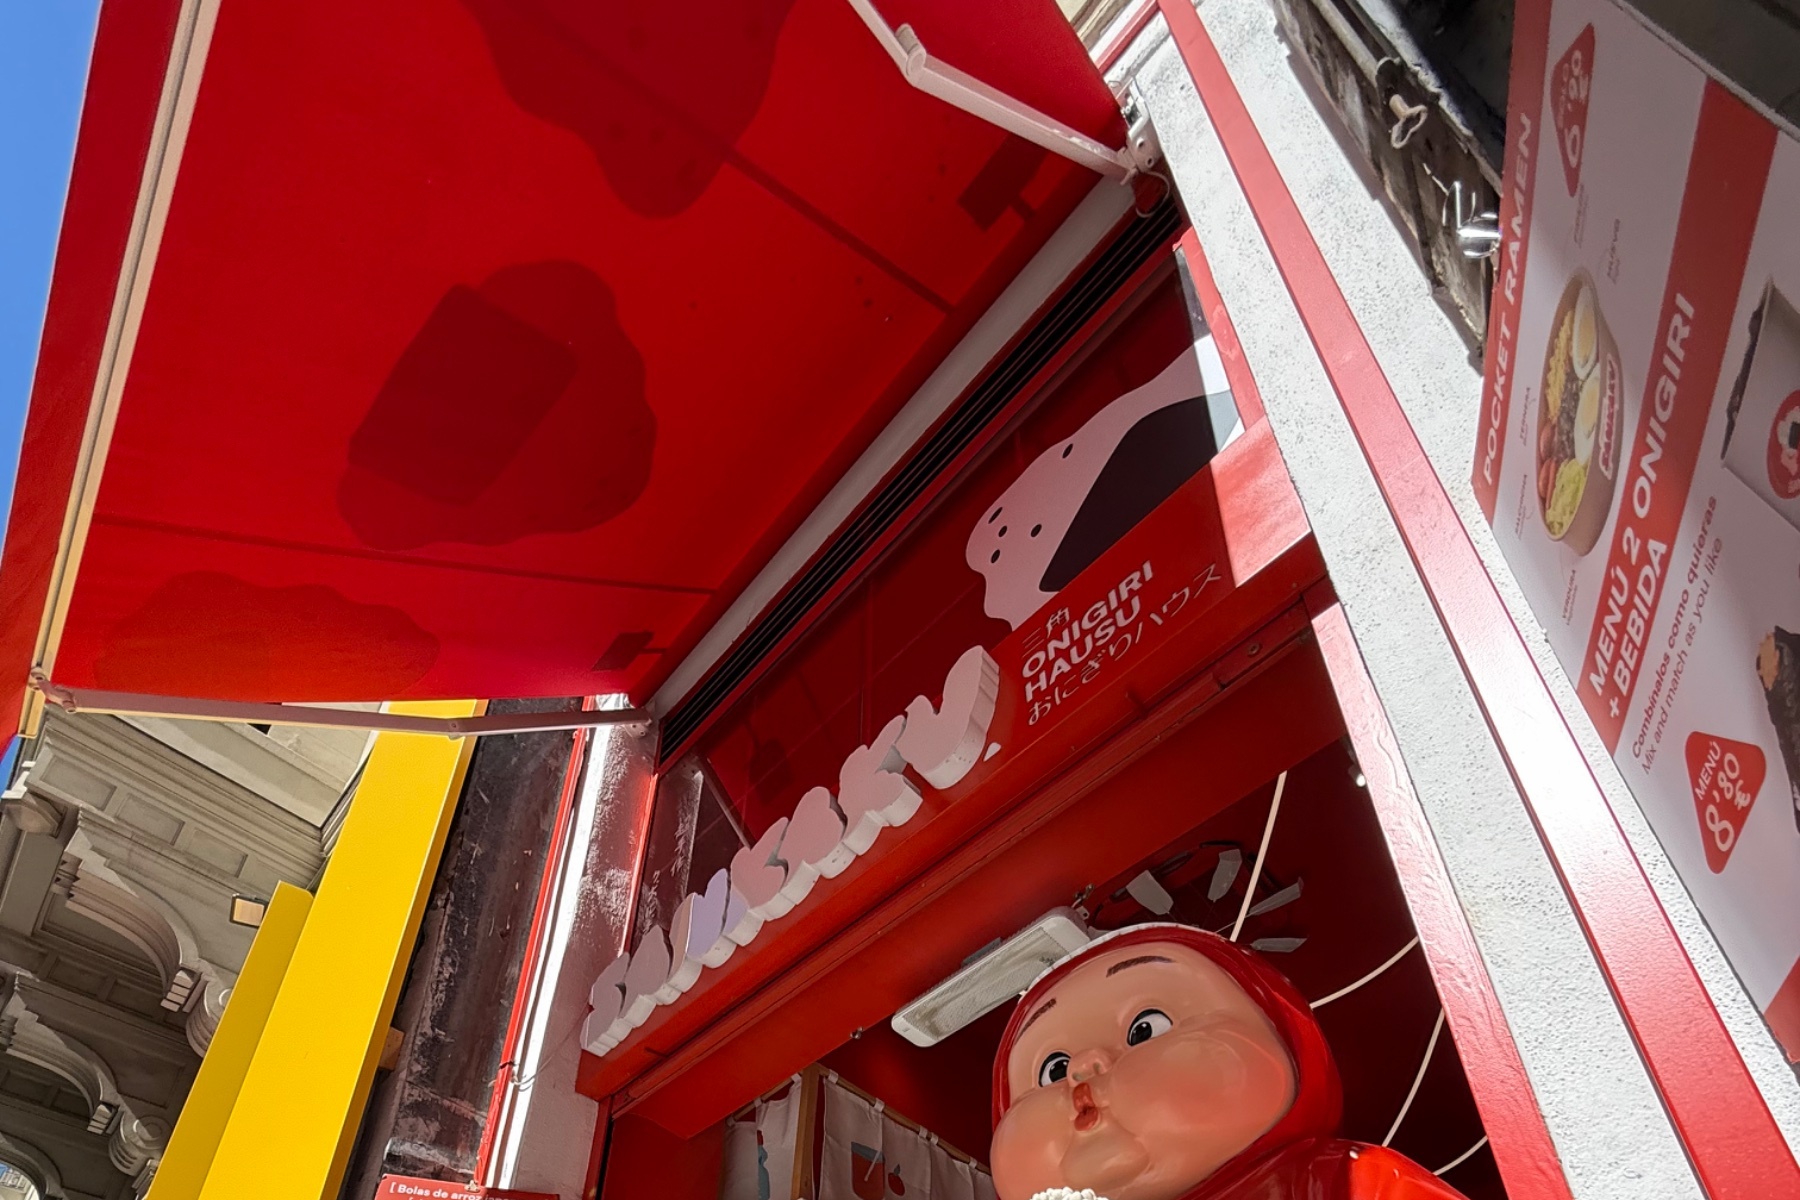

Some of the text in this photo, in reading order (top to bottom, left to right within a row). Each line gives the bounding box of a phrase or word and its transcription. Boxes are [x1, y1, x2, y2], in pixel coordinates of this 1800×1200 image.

[1483, 112, 1531, 486] POCKET RAMEN
[1589, 292, 1695, 696] MENÚ 2 ONIGIRI
[1021, 606, 1071, 660] 三角
[1022, 559, 1154, 679] ONIGIRI
[1024, 595, 1141, 703] HAUSU
[1028, 563, 1222, 726] おにぎりハウス
[1609, 539, 1667, 718] + BEBIDA
[1668, 589, 1689, 650] como
[1687, 496, 1717, 585] quieras
[1642, 537, 1722, 775] Mix and match as you like
[1695, 741, 1721, 801] MENÚ
[398, 1184, 431, 1197] Bolas
[433, 1189, 448, 1199] de
